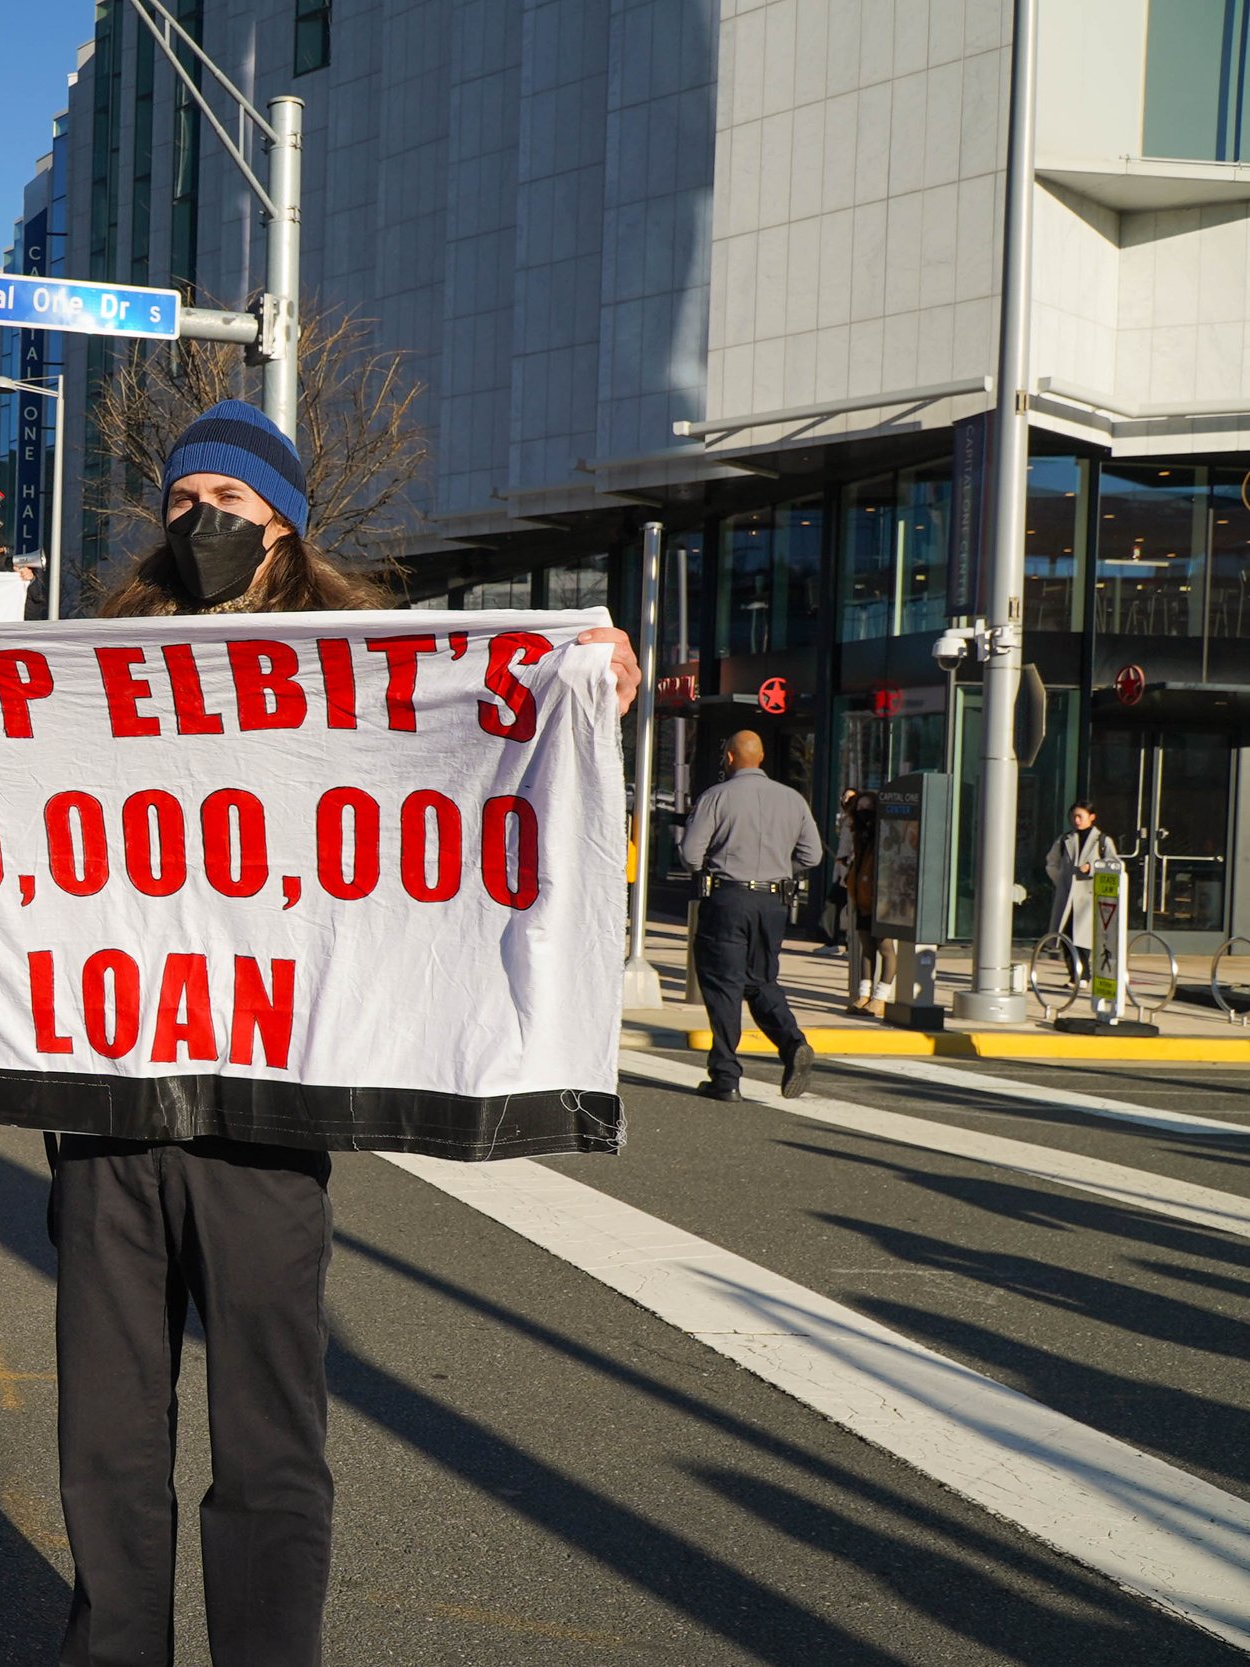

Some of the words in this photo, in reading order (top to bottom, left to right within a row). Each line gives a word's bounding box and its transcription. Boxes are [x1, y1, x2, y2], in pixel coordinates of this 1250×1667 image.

[33, 288, 83, 315] One
[100, 294, 130, 320] Dr
[24, 406, 38, 460] ONE
[95, 631, 554, 743] ELBIT'S
[27, 948, 296, 1071] LOAN
